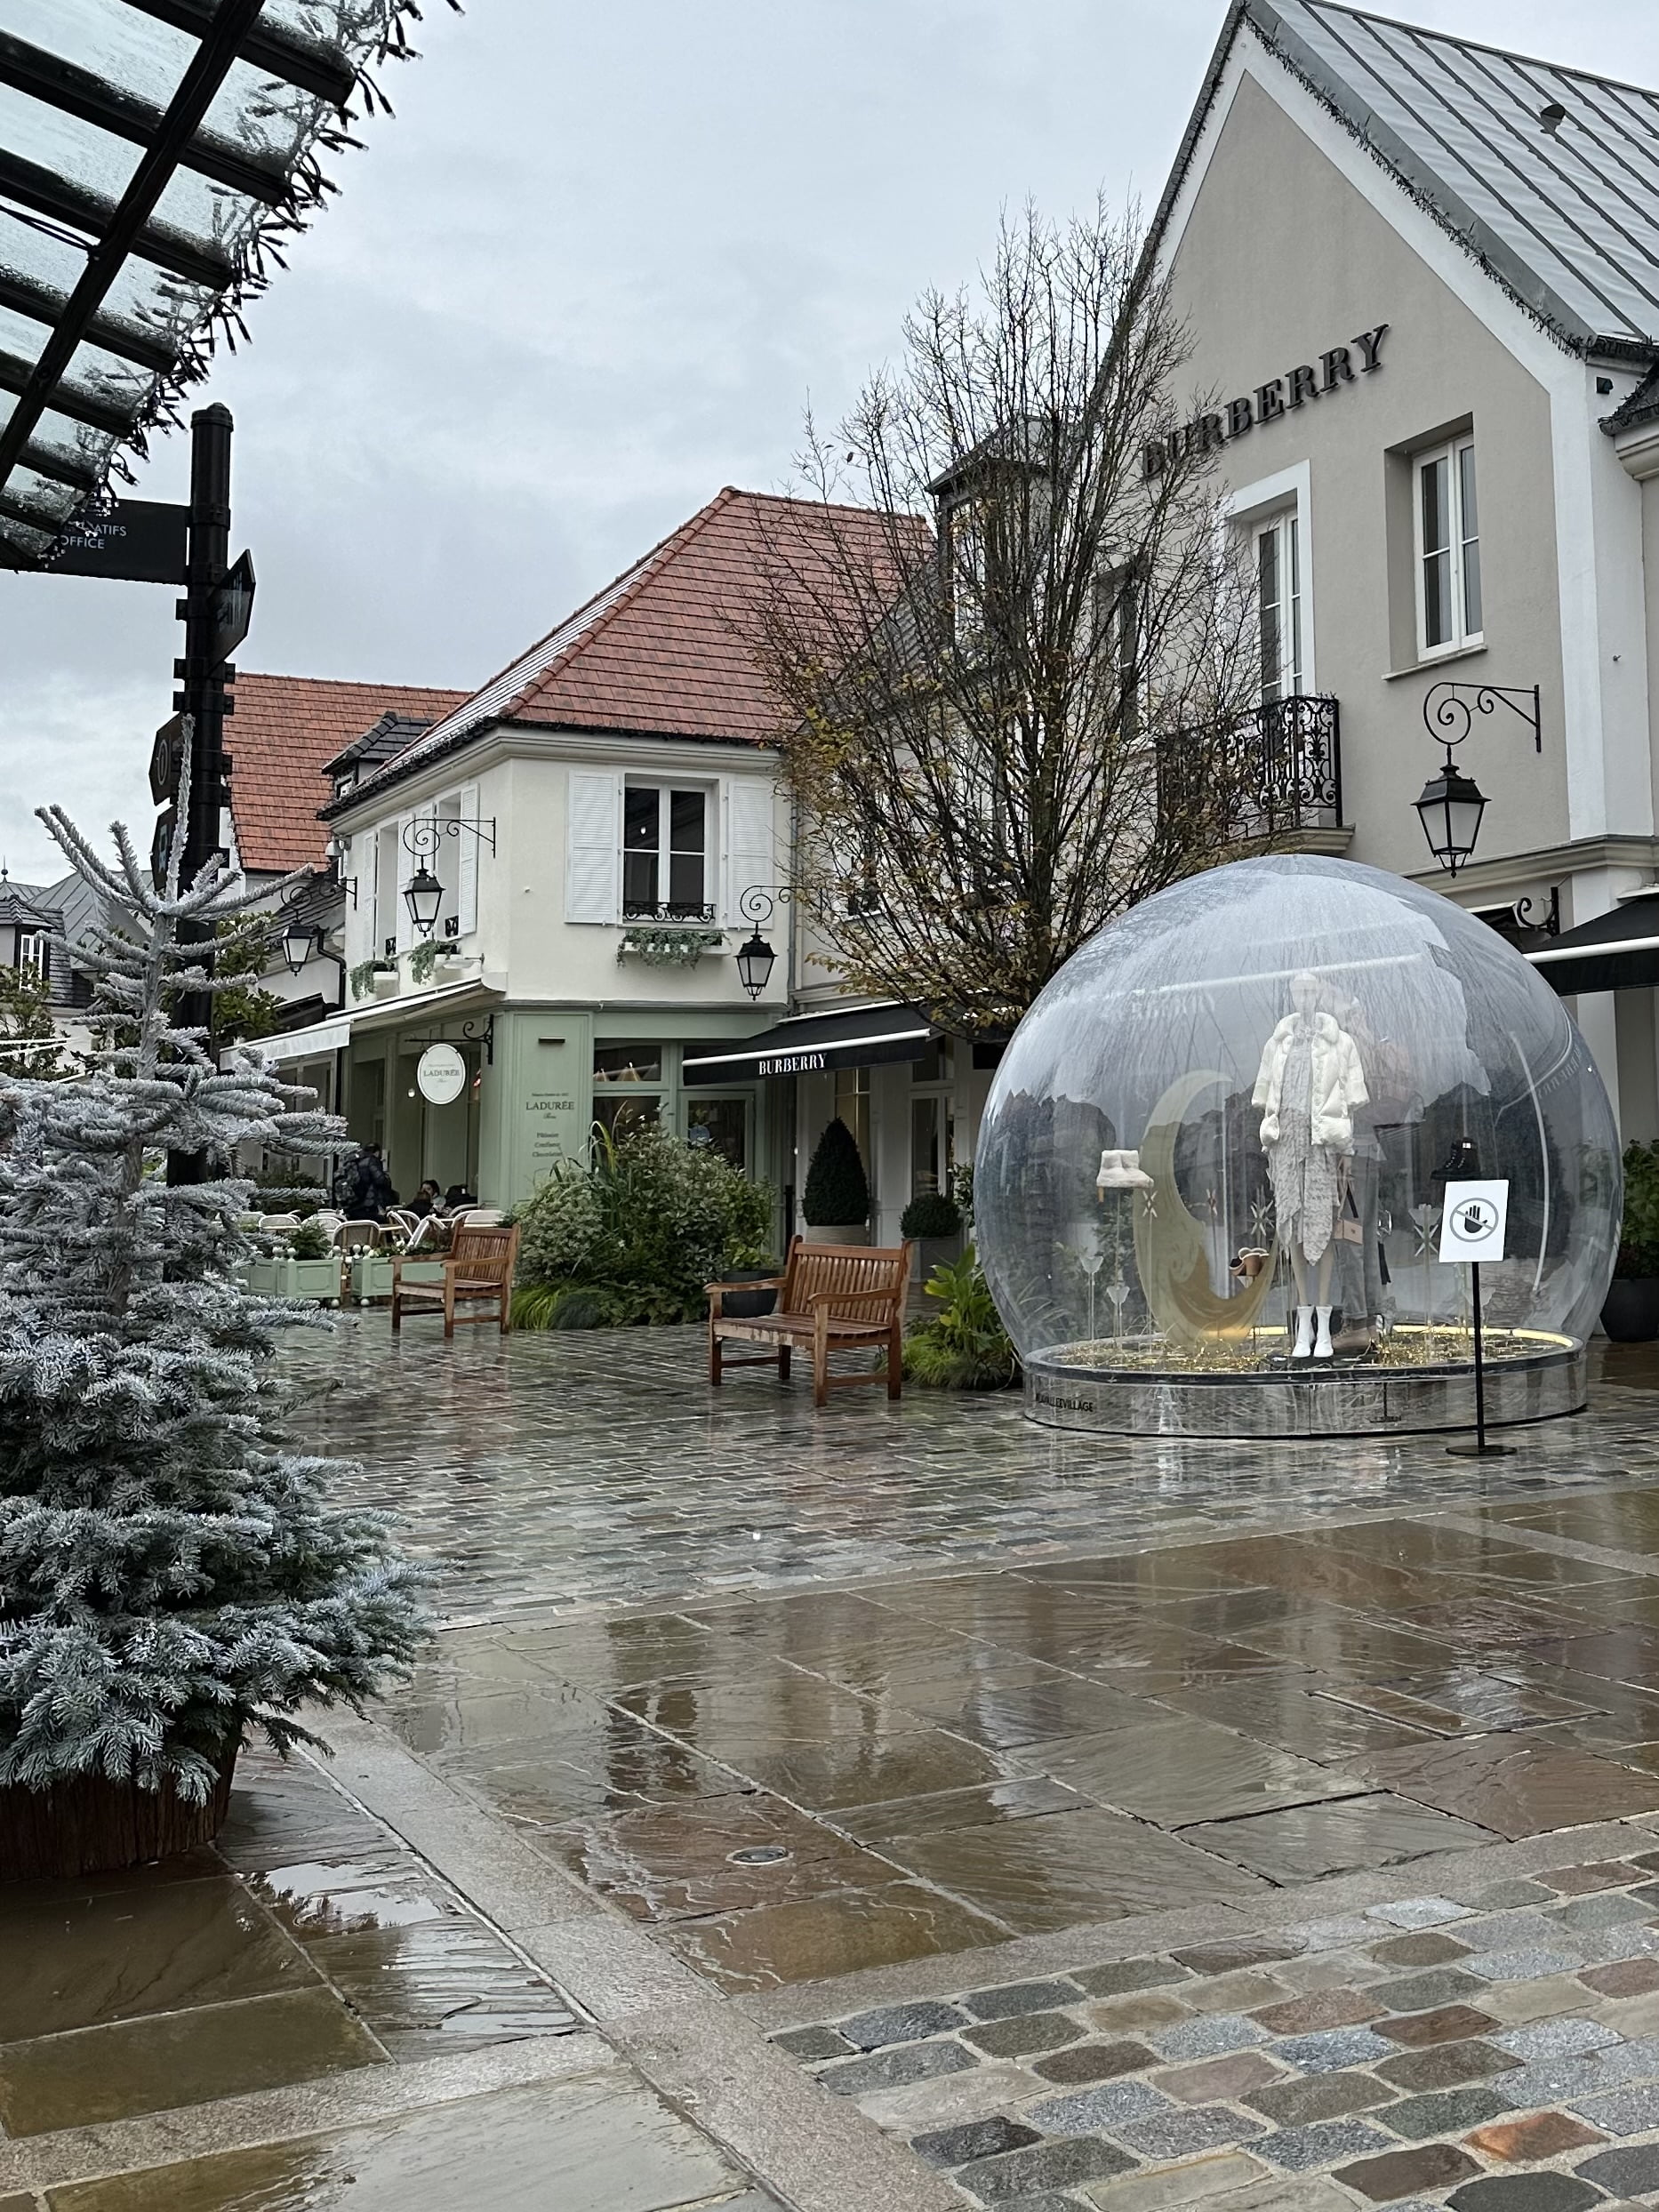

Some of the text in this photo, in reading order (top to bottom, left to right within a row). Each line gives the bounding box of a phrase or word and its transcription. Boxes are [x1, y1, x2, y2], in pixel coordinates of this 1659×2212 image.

[1142, 323, 1390, 481] BURBERRY
[60, 534, 105, 549] OFFICE
[758, 1054, 828, 1075] BURBERRY
[525, 1101, 575, 1110] LADURÉE
